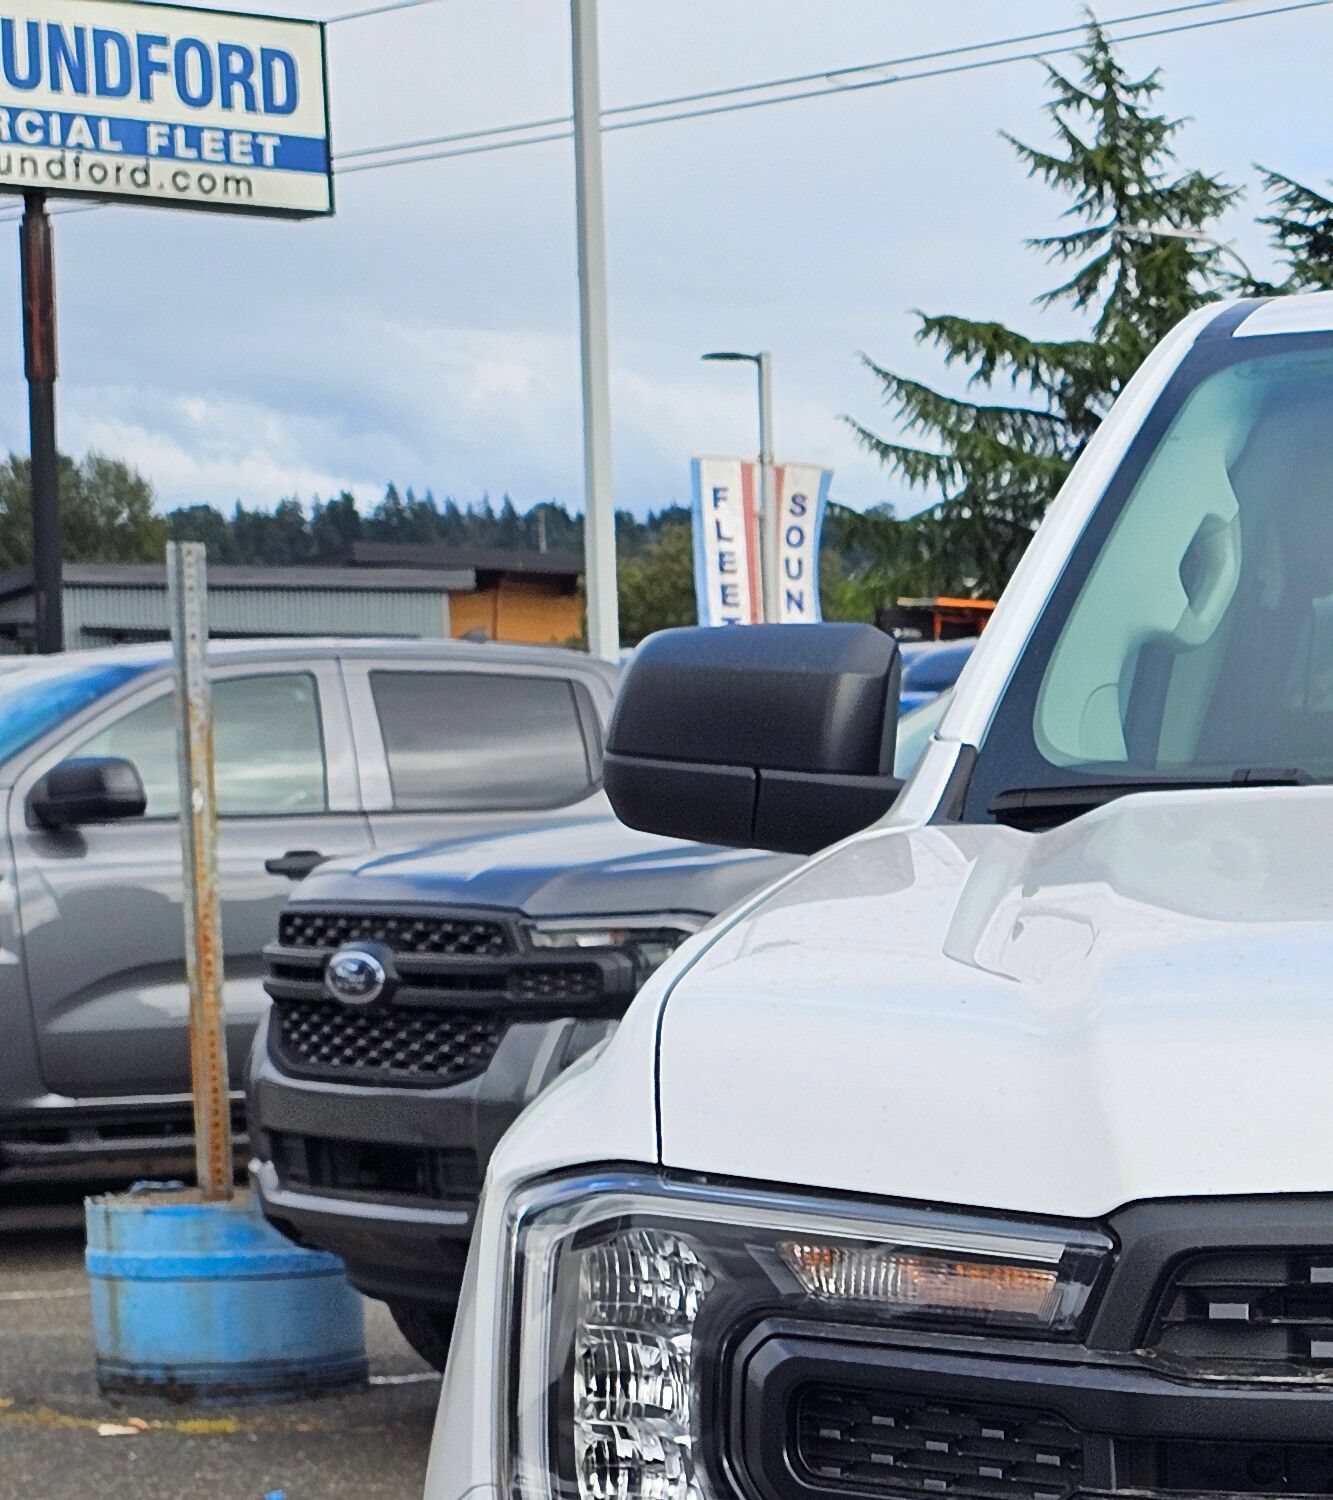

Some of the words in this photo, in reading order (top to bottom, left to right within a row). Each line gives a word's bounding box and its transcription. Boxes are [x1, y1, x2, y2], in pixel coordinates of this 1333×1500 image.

[1, 17, 299, 116] UNDFORD
[146, 124, 281, 167] FLEET
[785, 491, 809, 614] SOUN
